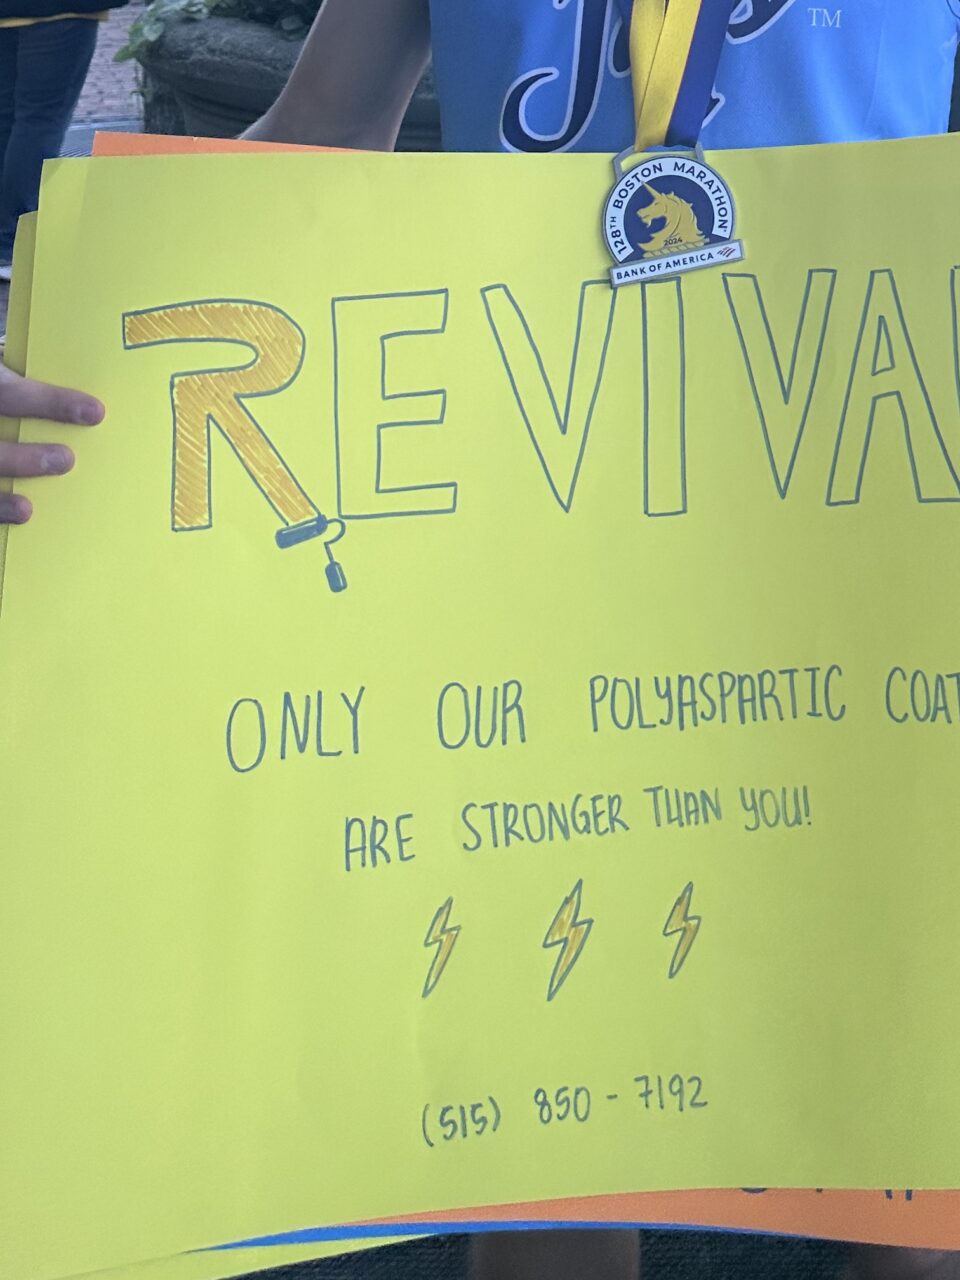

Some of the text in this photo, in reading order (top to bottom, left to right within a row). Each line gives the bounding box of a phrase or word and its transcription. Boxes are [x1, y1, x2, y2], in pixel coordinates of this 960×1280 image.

[609, 161, 729, 256] 128TH BOSTON MARATHON
[663, 236, 683, 247] 2024
[616, 252, 715, 281] BANK OF AMERICA
[226, 686, 366, 773] ONLY
[437, 679, 527, 750] OUR
[589, 664, 847, 733] POLYASPARTIC
[345, 785, 813, 872] ARE STRONGER THAN YOU!
[422, 1085, 502, 1147] (515)
[534, 1086, 591, 1124] 850
[634, 1074, 708, 1112] 7192
